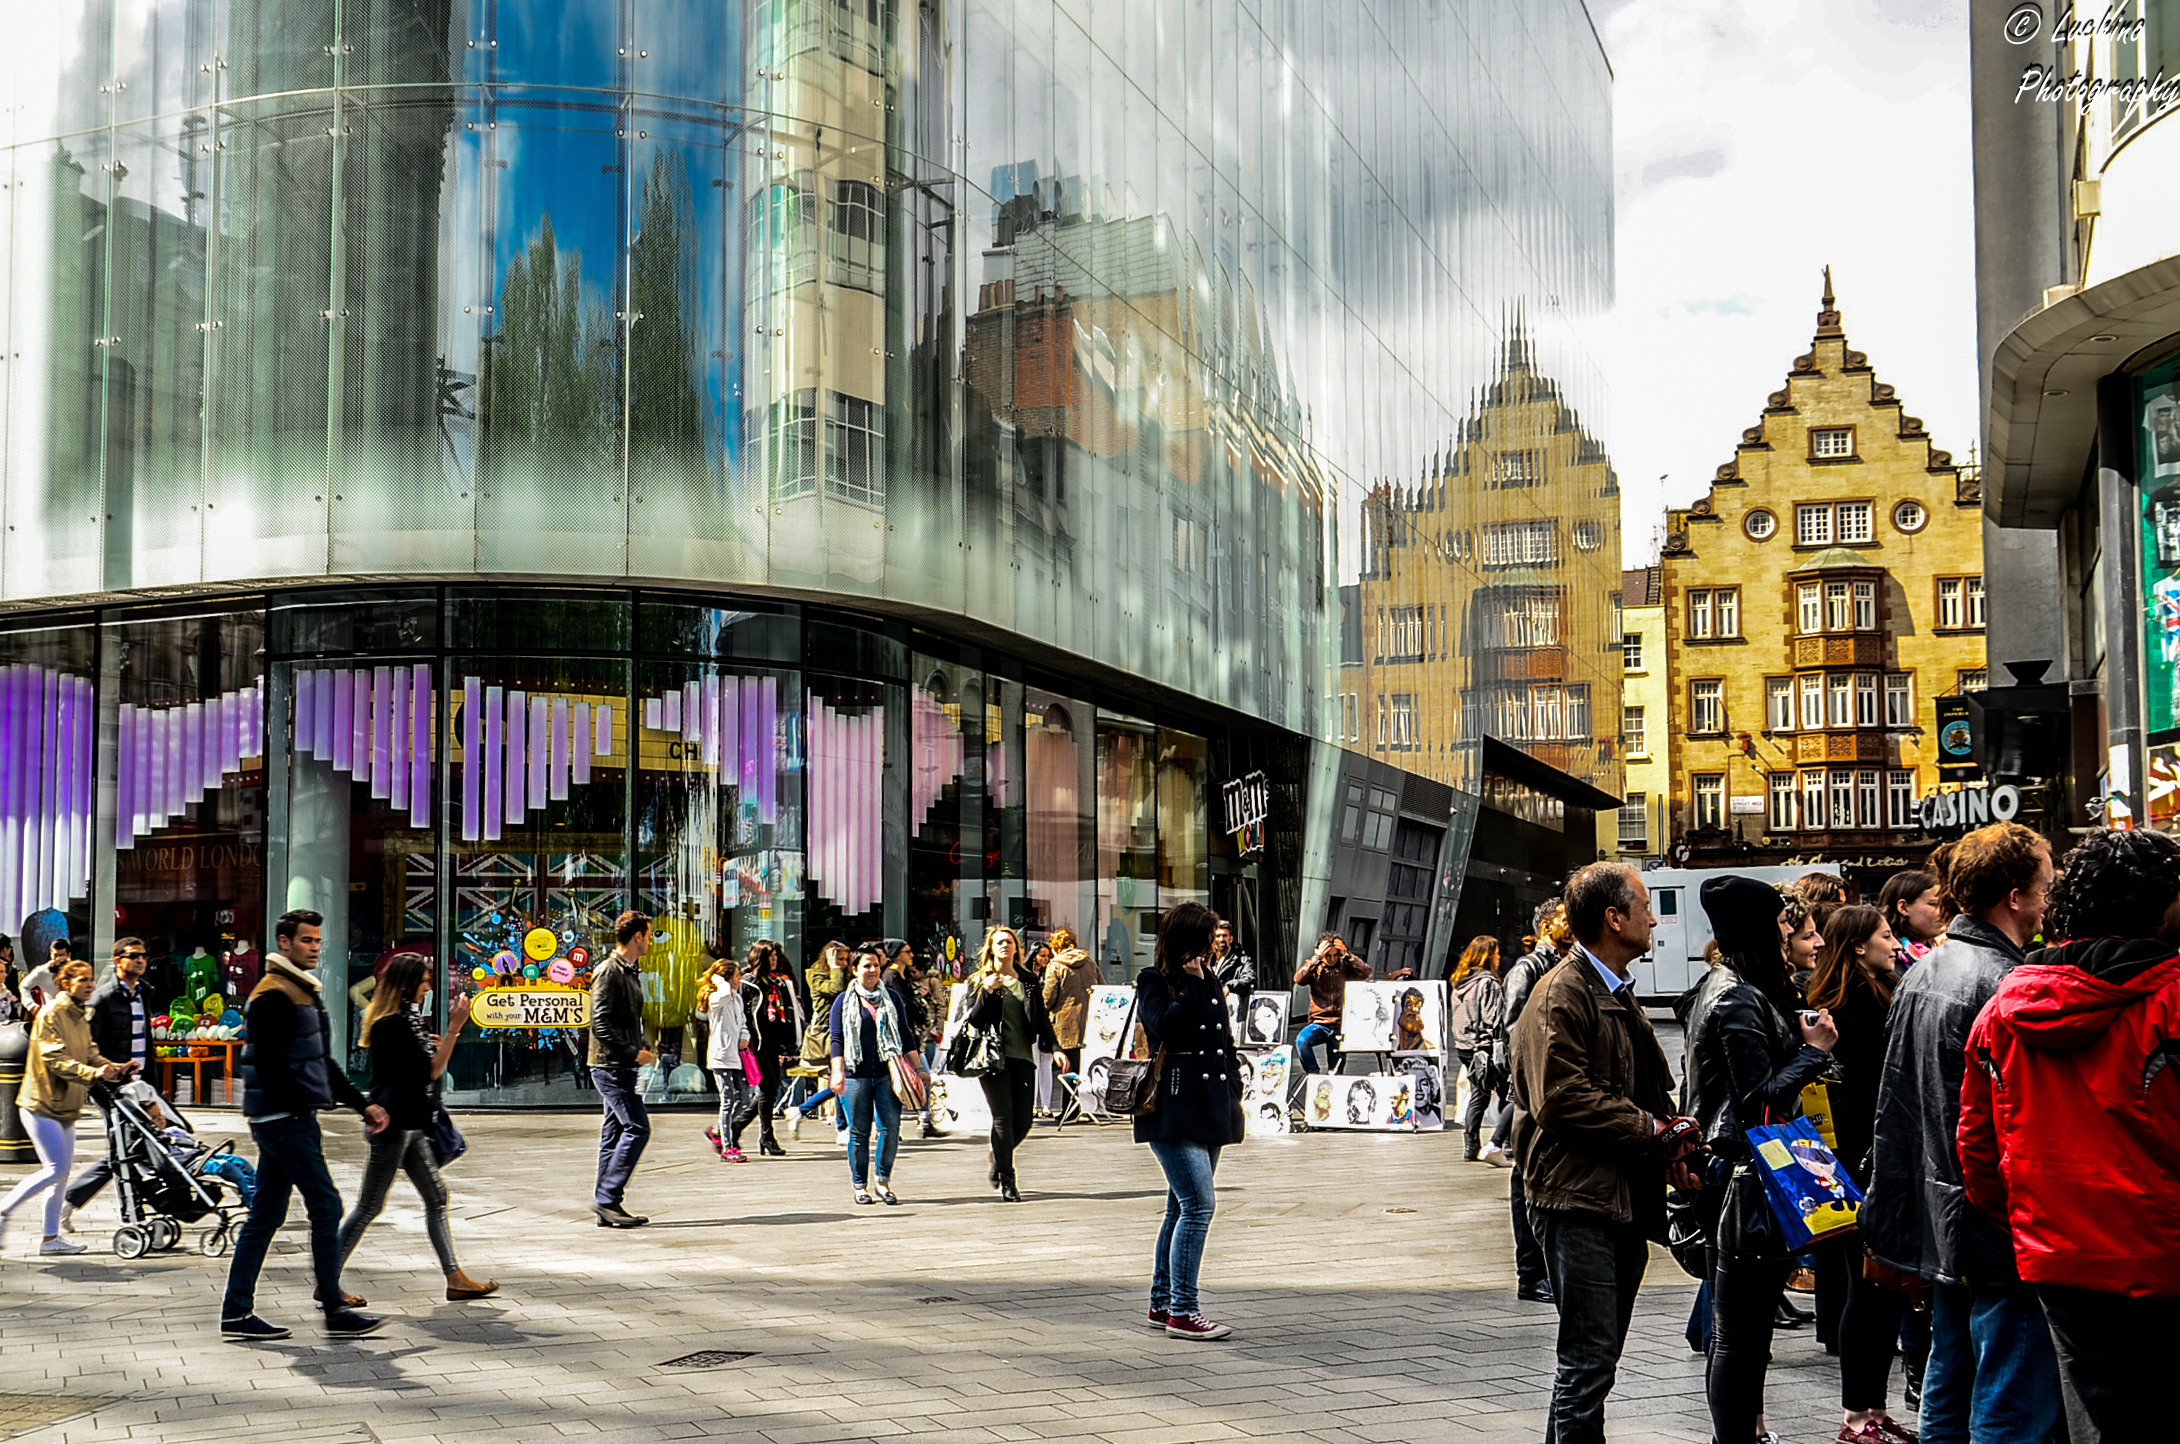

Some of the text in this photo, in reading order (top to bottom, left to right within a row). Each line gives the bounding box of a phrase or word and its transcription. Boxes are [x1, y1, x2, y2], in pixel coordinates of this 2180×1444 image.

[1921, 784, 2021, 829] CASINO
[131, 846, 195, 872] WORLD
[486, 993, 583, 1007] Get Personal
[486, 1008, 583, 1024] with your M&M'S
